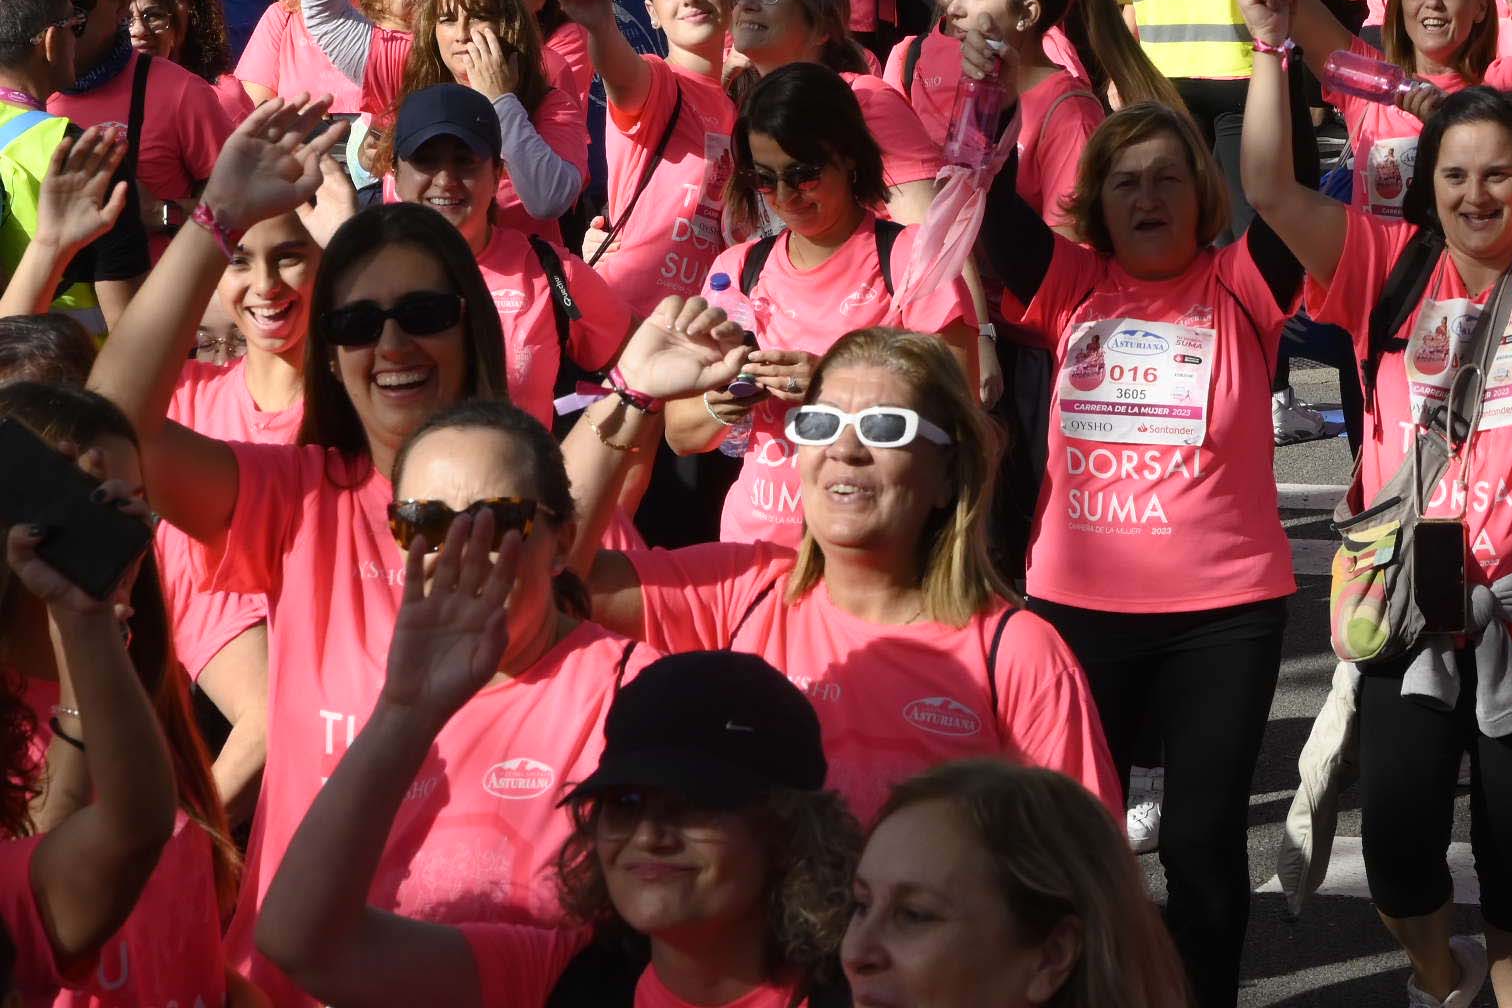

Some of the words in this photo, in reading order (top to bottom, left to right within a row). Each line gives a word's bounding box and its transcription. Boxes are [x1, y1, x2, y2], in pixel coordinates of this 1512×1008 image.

[1111, 337, 1165, 351] ASTURIANA
[1109, 364, 1158, 383] 016
[1115, 387, 1147, 400] 3605
[1073, 402, 1113, 412] CARRERA
[1114, 404, 1126, 413] DE
[1128, 405, 1139, 413] LA
[1139, 406, 1170, 415] MUJER
[1172, 408, 1192, 417] 2023
[1070, 419, 1113, 433] OYSHO
[1149, 424, 1195, 435] Santander
[1067, 488, 1169, 524] SUMA
[910, 705, 977, 731] ASTURIANA
